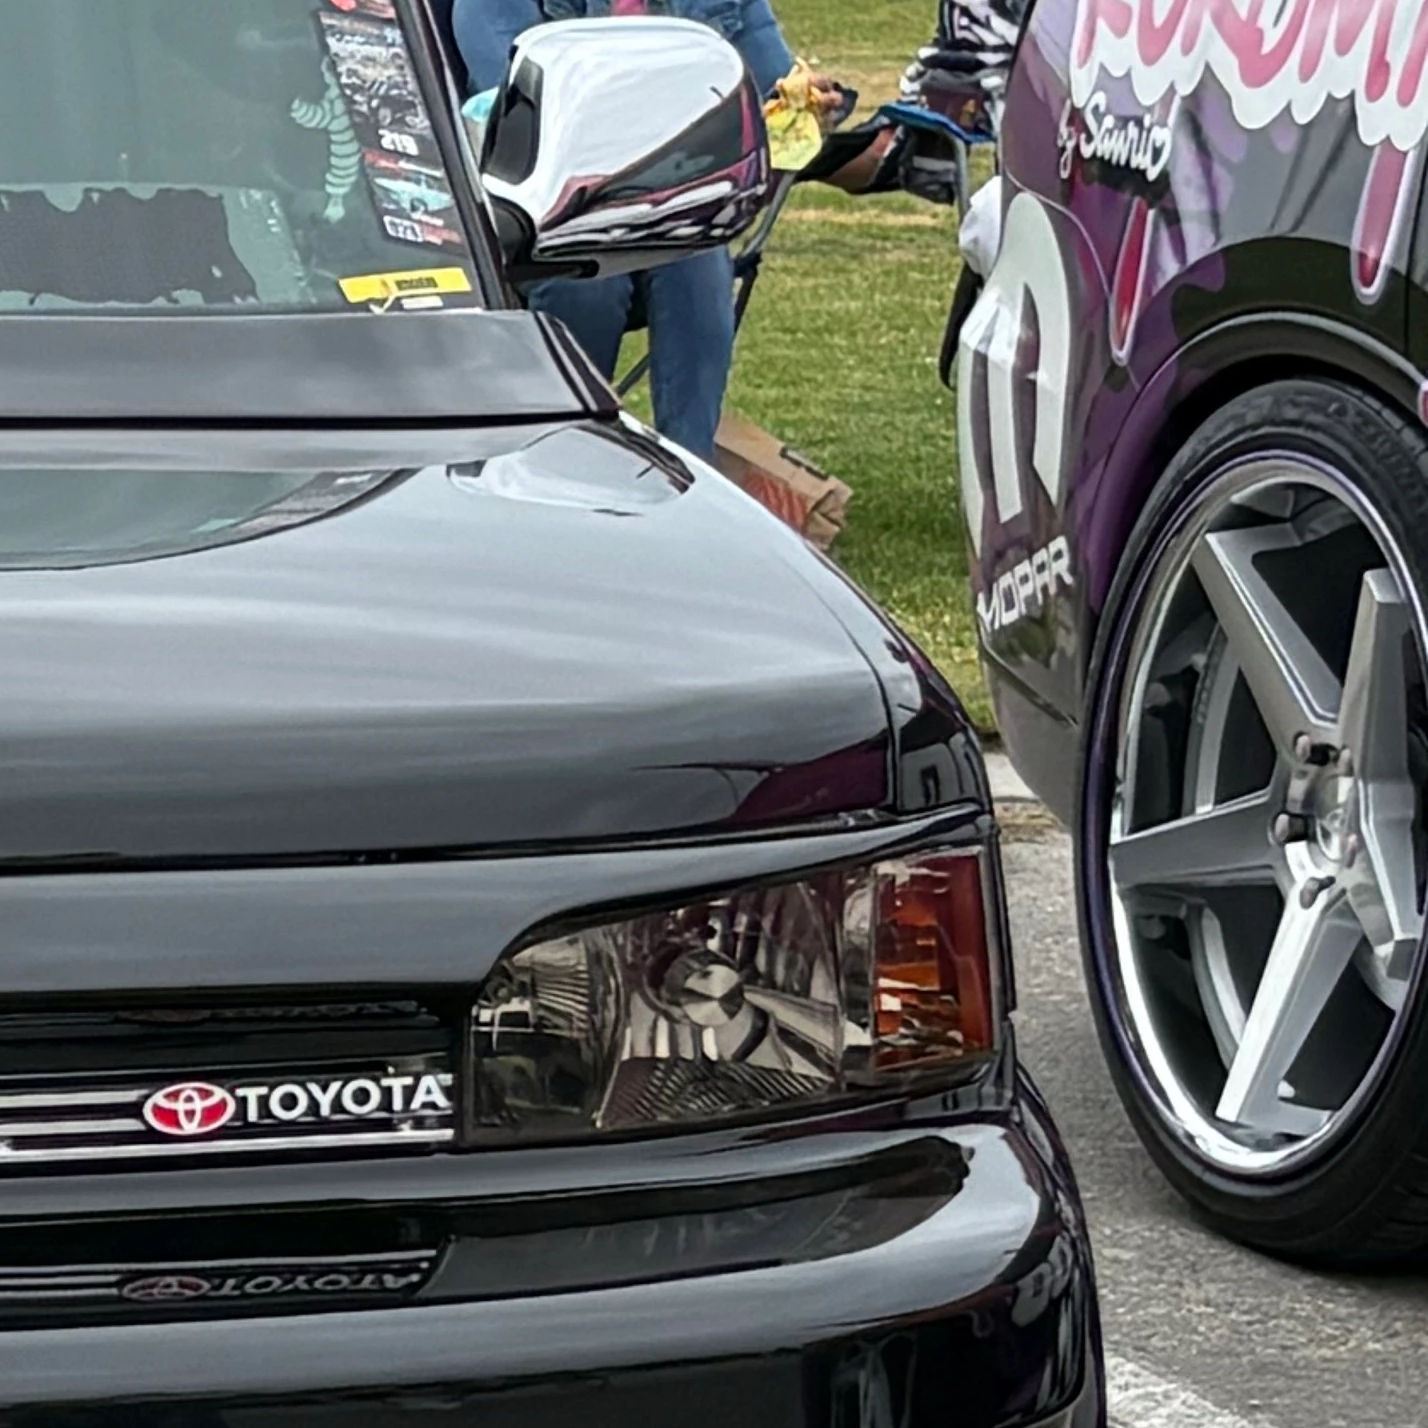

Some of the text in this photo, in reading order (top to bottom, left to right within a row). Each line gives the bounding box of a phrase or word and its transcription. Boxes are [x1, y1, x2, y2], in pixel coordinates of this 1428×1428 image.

[1081, 91, 1172, 181] Sanrio
[977, 536, 1074, 632] MOPAR
[236, 1073, 454, 1123] TOYOTA
